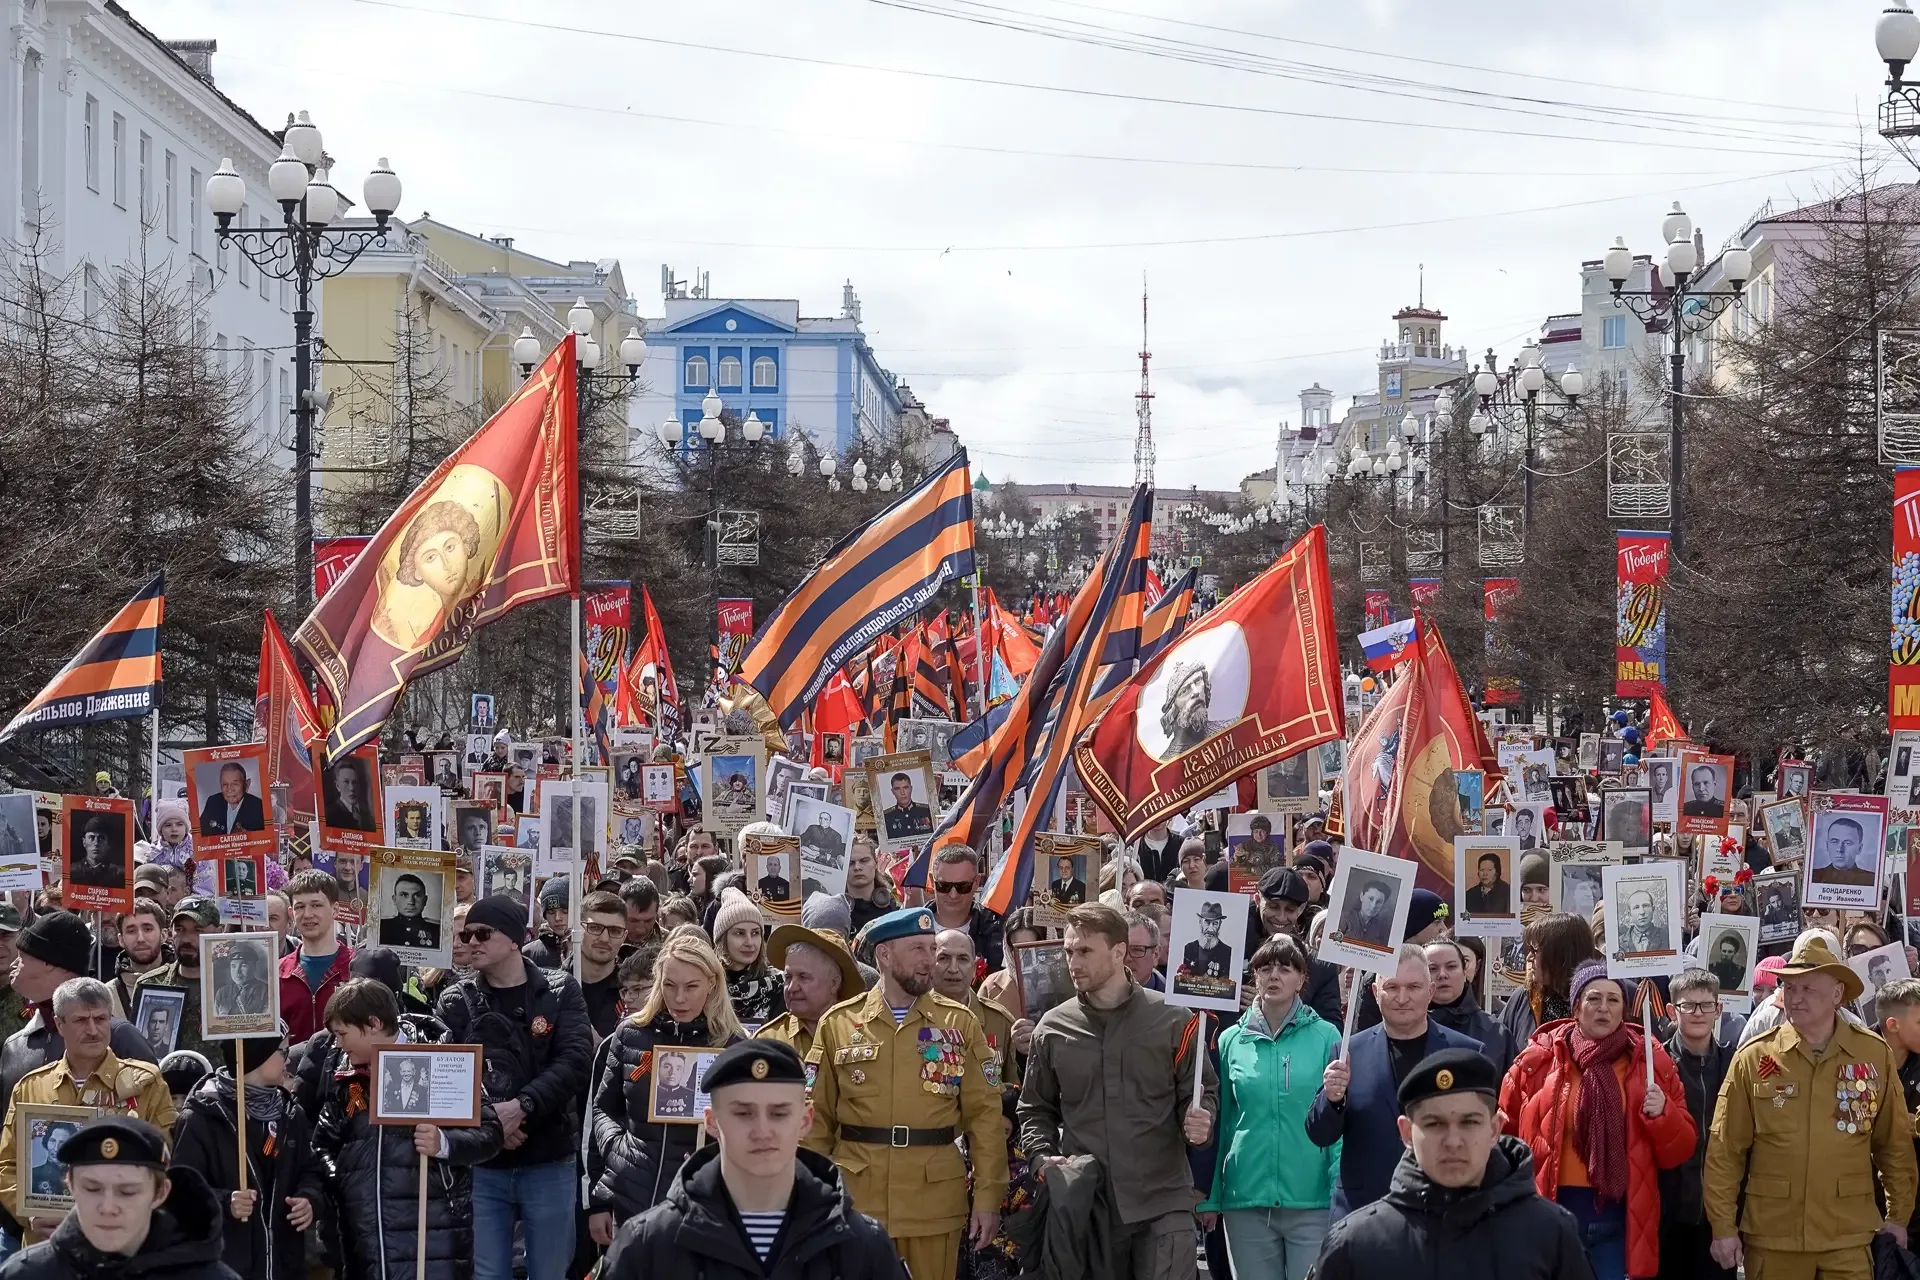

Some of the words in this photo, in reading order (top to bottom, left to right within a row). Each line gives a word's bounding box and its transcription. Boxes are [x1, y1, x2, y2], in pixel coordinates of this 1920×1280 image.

[1618, 542, 1669, 575] Победа!
[586, 590, 630, 618] Победа!
[718, 606, 752, 628] Победа!
[1618, 661, 1661, 681] МАЯ
[85, 691, 150, 718] Движение
[1500, 743, 1532, 751] Колосов
[219, 834, 247, 843] САЛТАНОВ
[1821, 887, 1862, 895] БОНДАРЕНКО
[1836, 895, 1865, 903] Иванович
